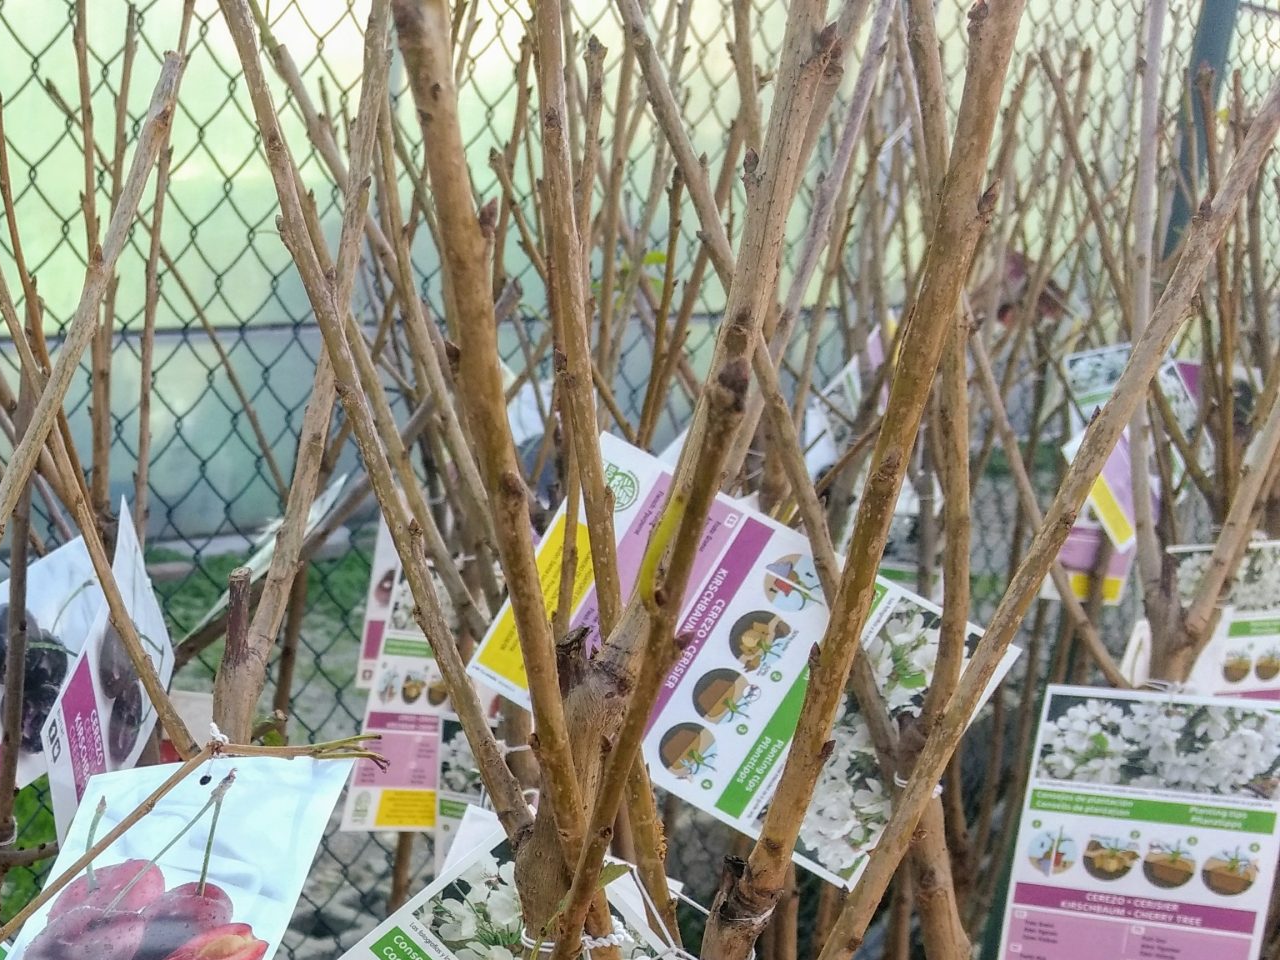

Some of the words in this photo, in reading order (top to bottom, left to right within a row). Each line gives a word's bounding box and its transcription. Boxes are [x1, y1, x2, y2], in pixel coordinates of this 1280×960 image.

[681, 567, 729, 634] KIRSCHBAUM
[694, 597, 726, 639] CEREZO
[664, 644, 697, 689] CERISIER
[89, 706, 104, 767] CEREZO
[755, 738, 784, 776] Planting
[735, 734, 772, 785] Pflanztipps
[744, 773, 762, 794] tips
[1059, 900, 1126, 916] KIRSCHBAUM
[1133, 909, 1174, 922] CHERRY
[1174, 915, 1203, 926] TREE
[1085, 892, 1125, 905] CEREZO
[1133, 898, 1179, 911] CERISIER
